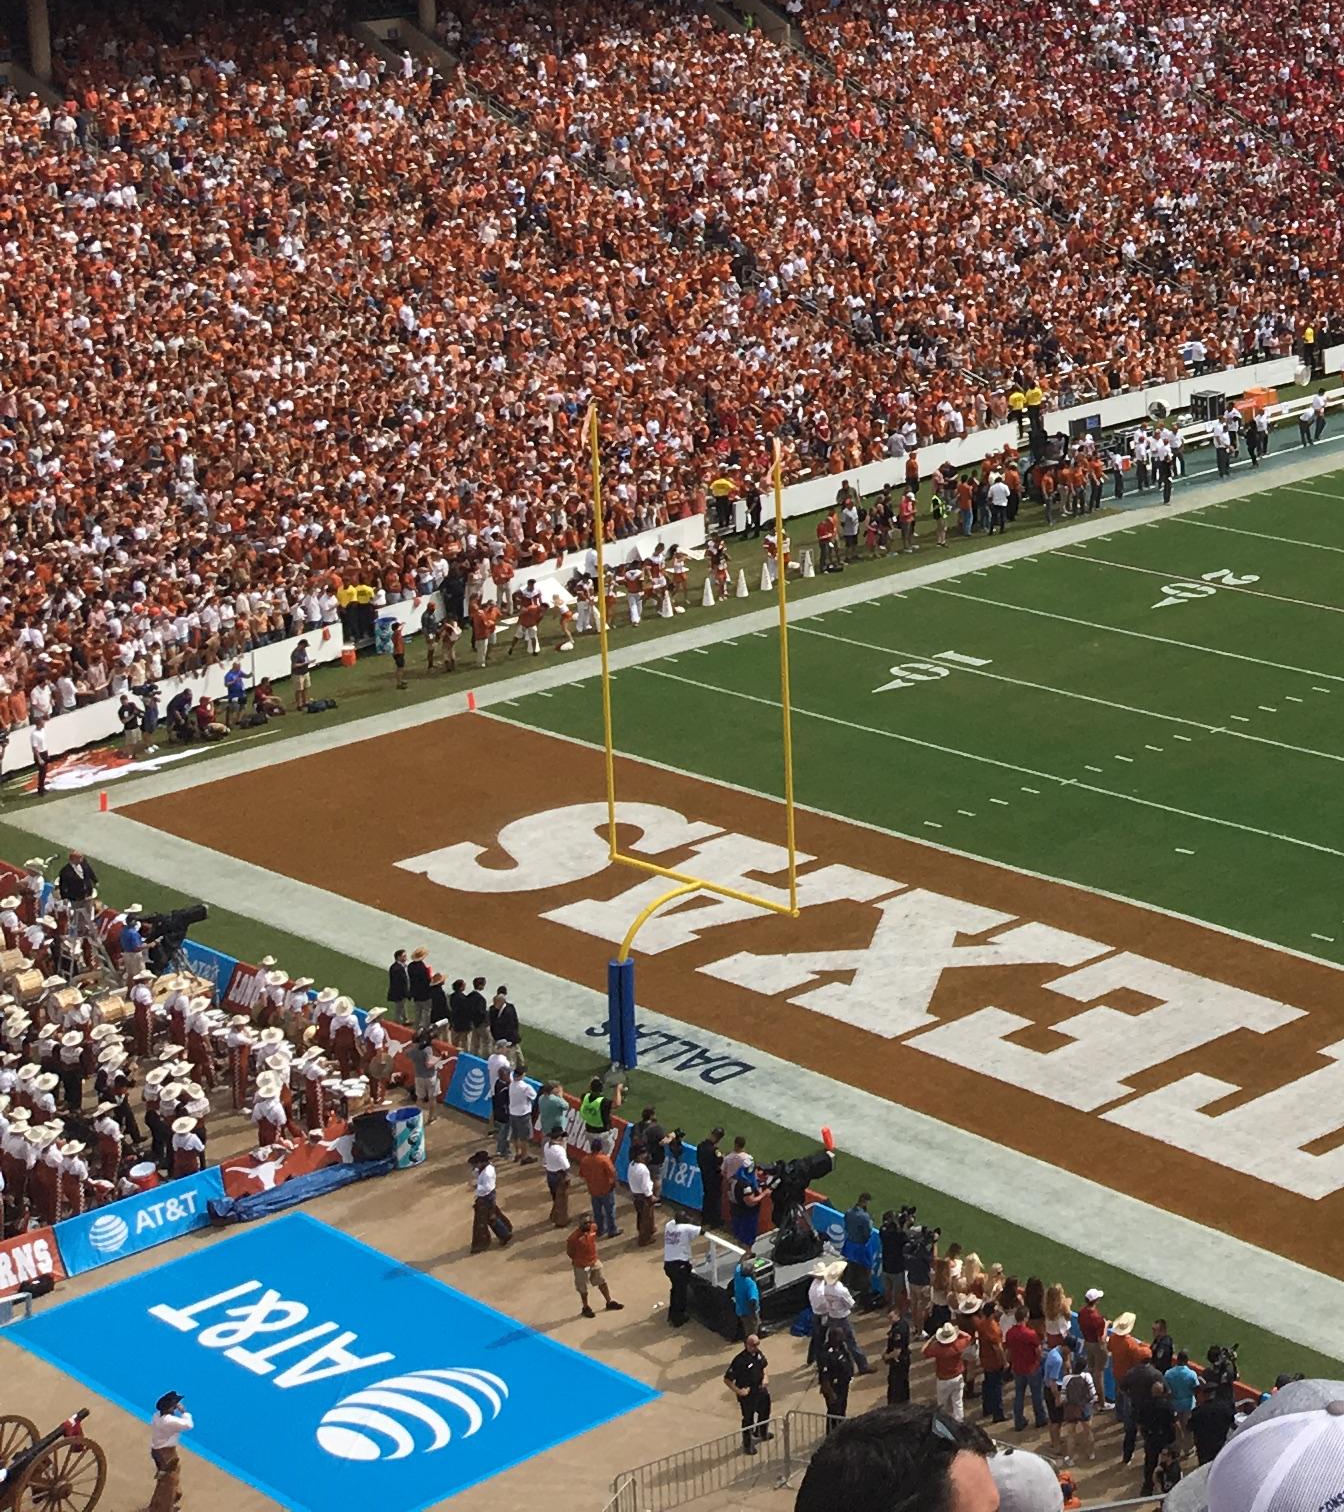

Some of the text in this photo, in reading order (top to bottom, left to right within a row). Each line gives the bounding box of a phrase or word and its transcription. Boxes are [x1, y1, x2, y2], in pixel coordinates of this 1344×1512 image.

[1160, 568, 1261, 600] 20
[897, 650, 993, 684] 10
[585, 1020, 756, 1086] DALLS
[136, 1191, 198, 1234] AT&T
[148, 1279, 395, 1389] AT&T
